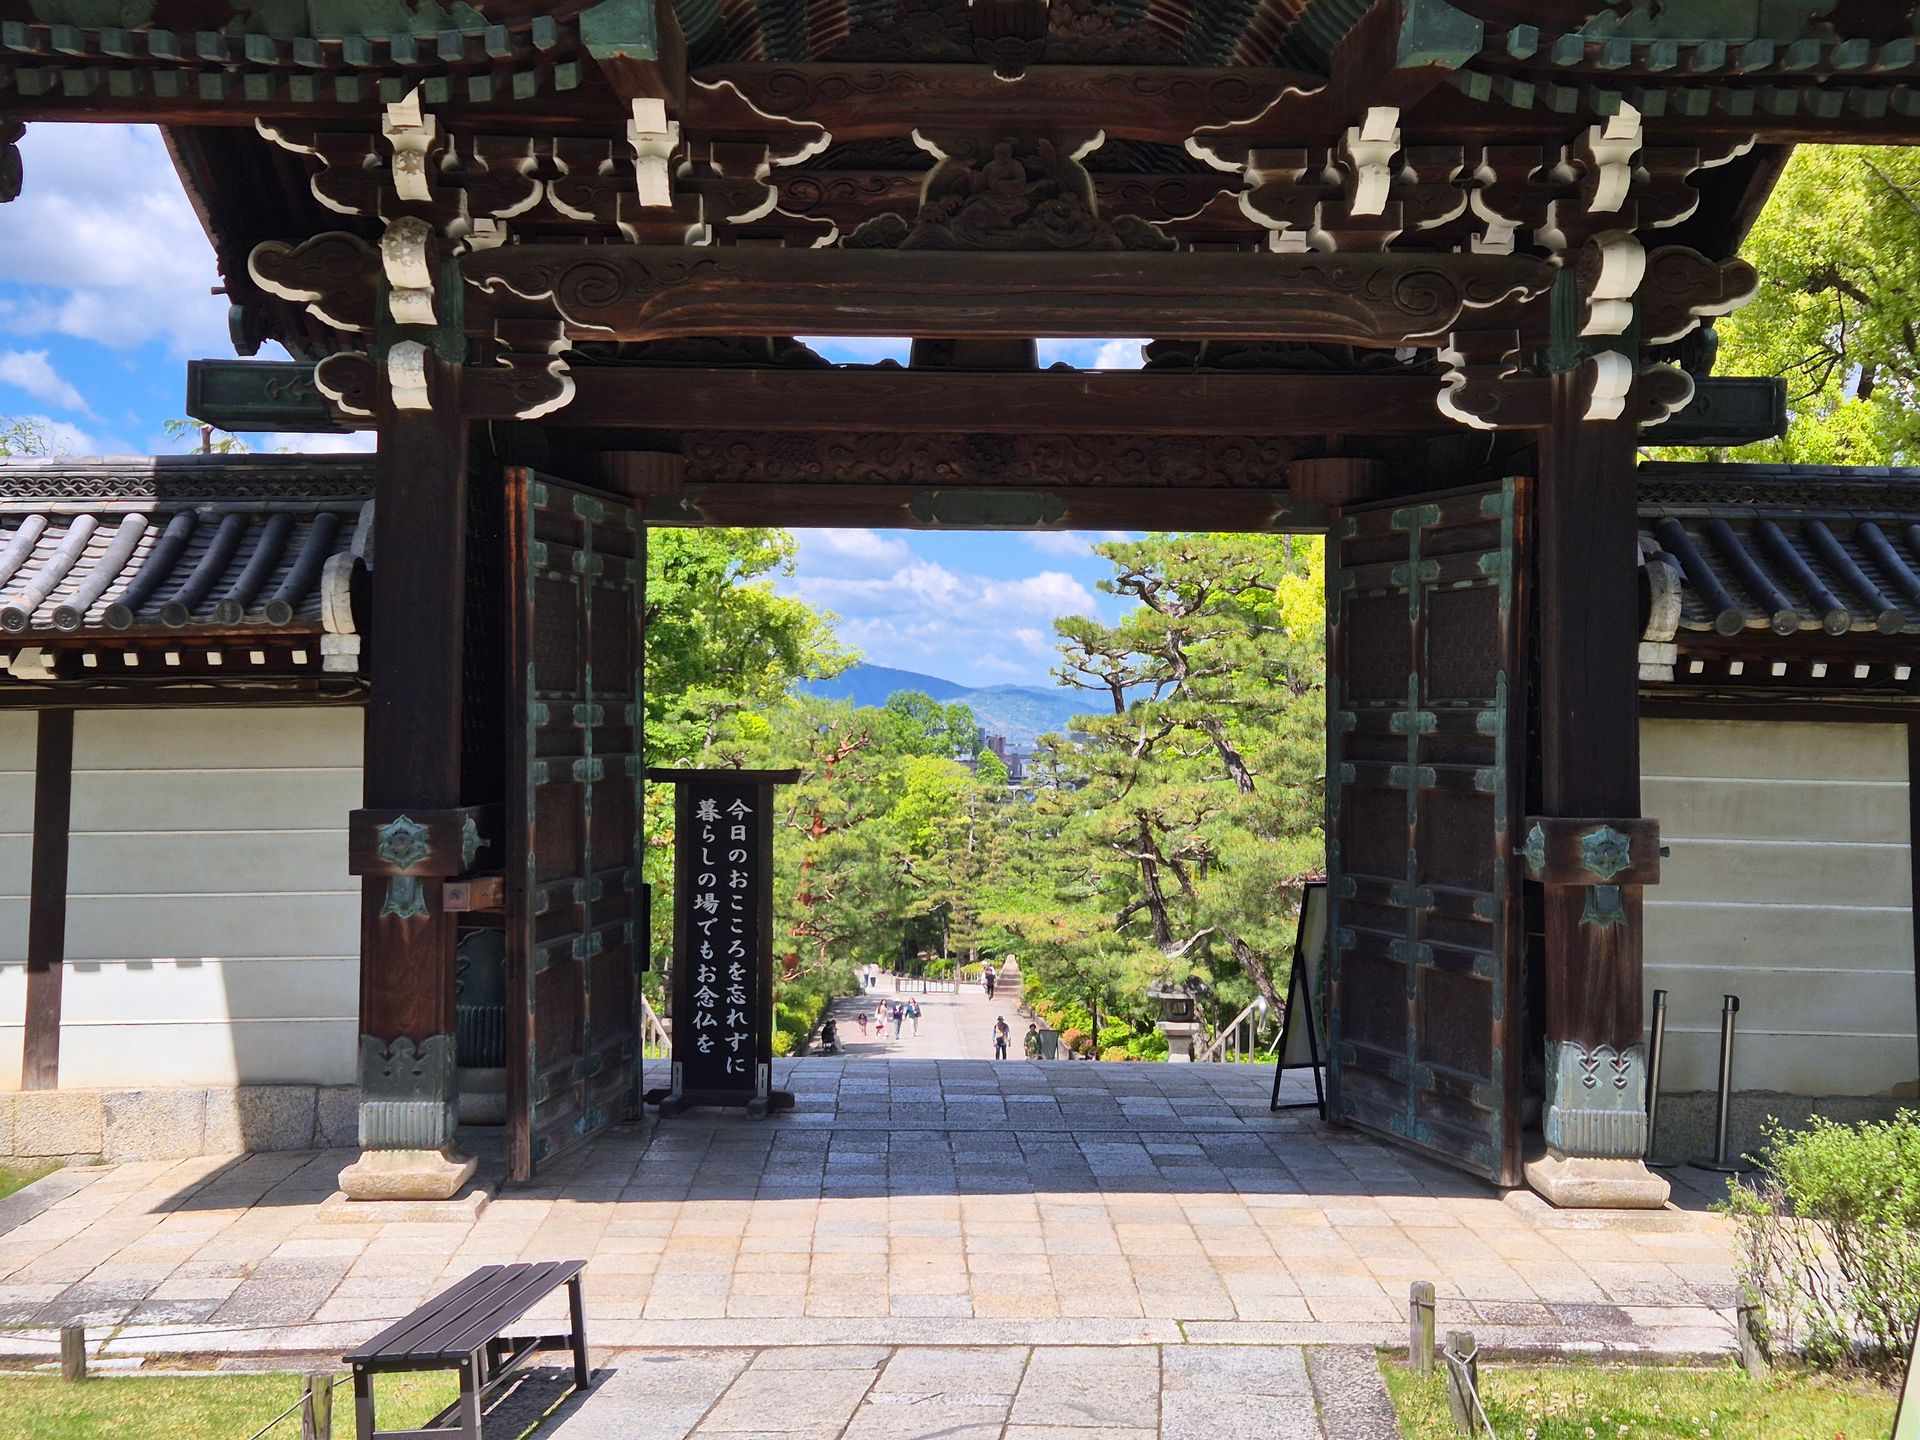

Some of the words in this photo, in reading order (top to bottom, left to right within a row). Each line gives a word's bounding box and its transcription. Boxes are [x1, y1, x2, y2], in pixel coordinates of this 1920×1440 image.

[692, 798, 723, 1054] 暮らしの場でもお念仏を
[725, 798, 753, 1074] 今日のおこころを忘れずに
